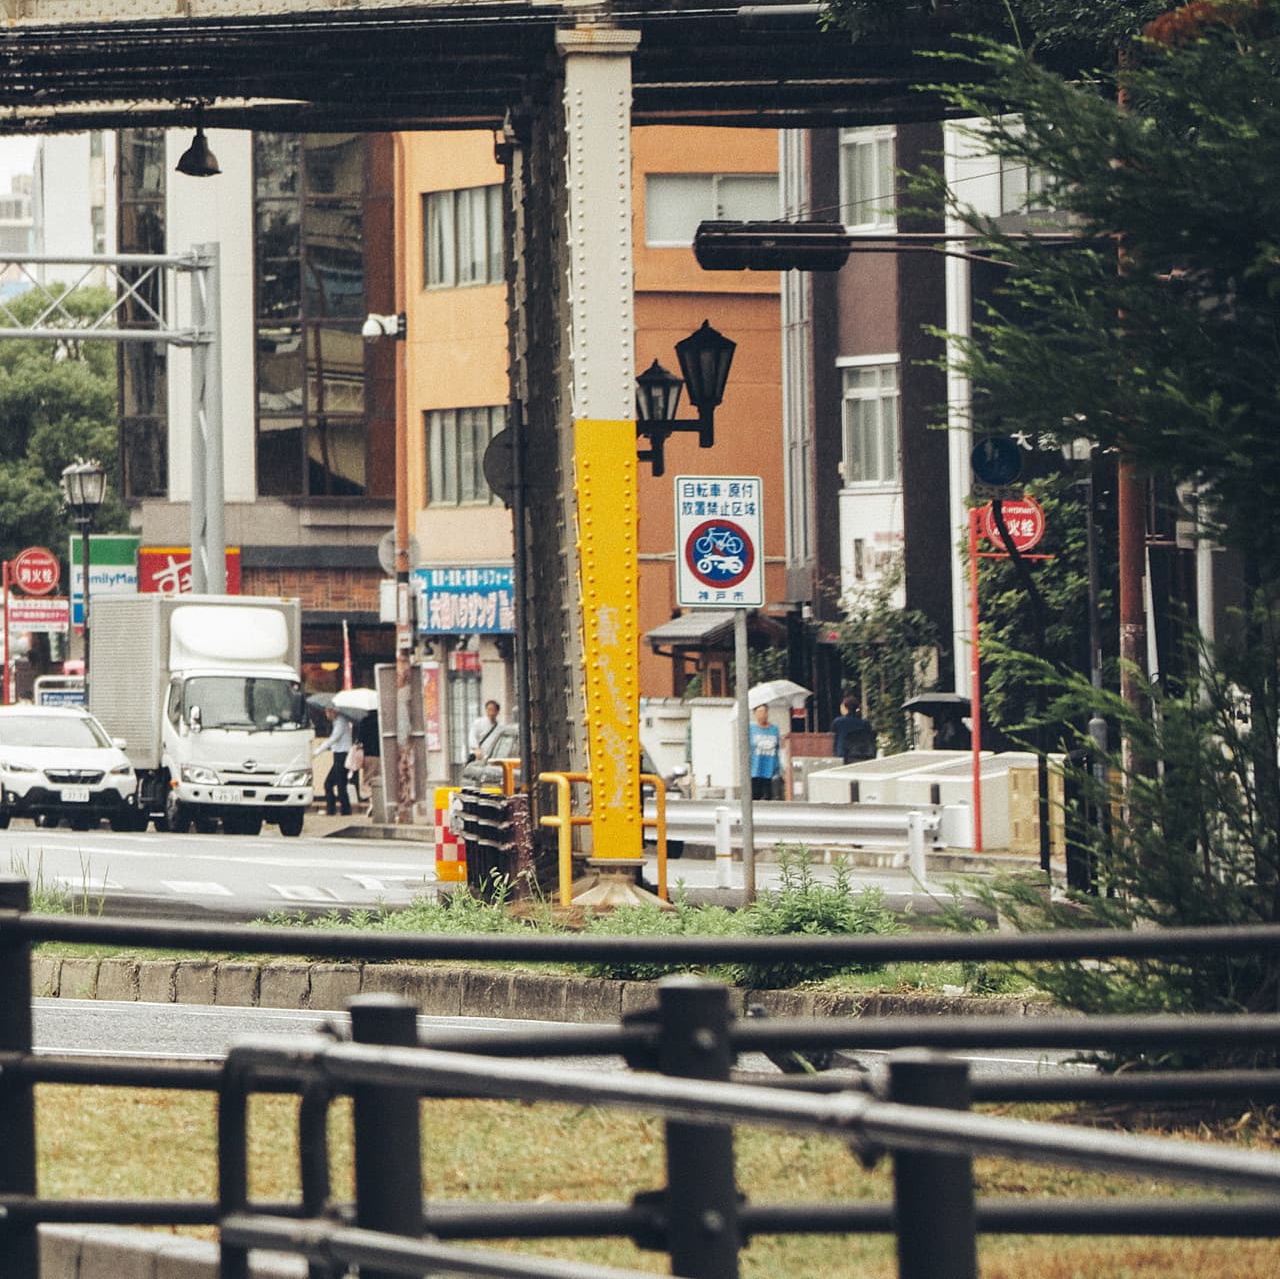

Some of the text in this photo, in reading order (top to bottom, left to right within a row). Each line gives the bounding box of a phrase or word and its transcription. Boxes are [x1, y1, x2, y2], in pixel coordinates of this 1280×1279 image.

[683, 483, 753, 498] 自転車・原付
[682, 501, 756, 516] 放置禁止区域
[76, 573, 139, 587] FmilyMar
